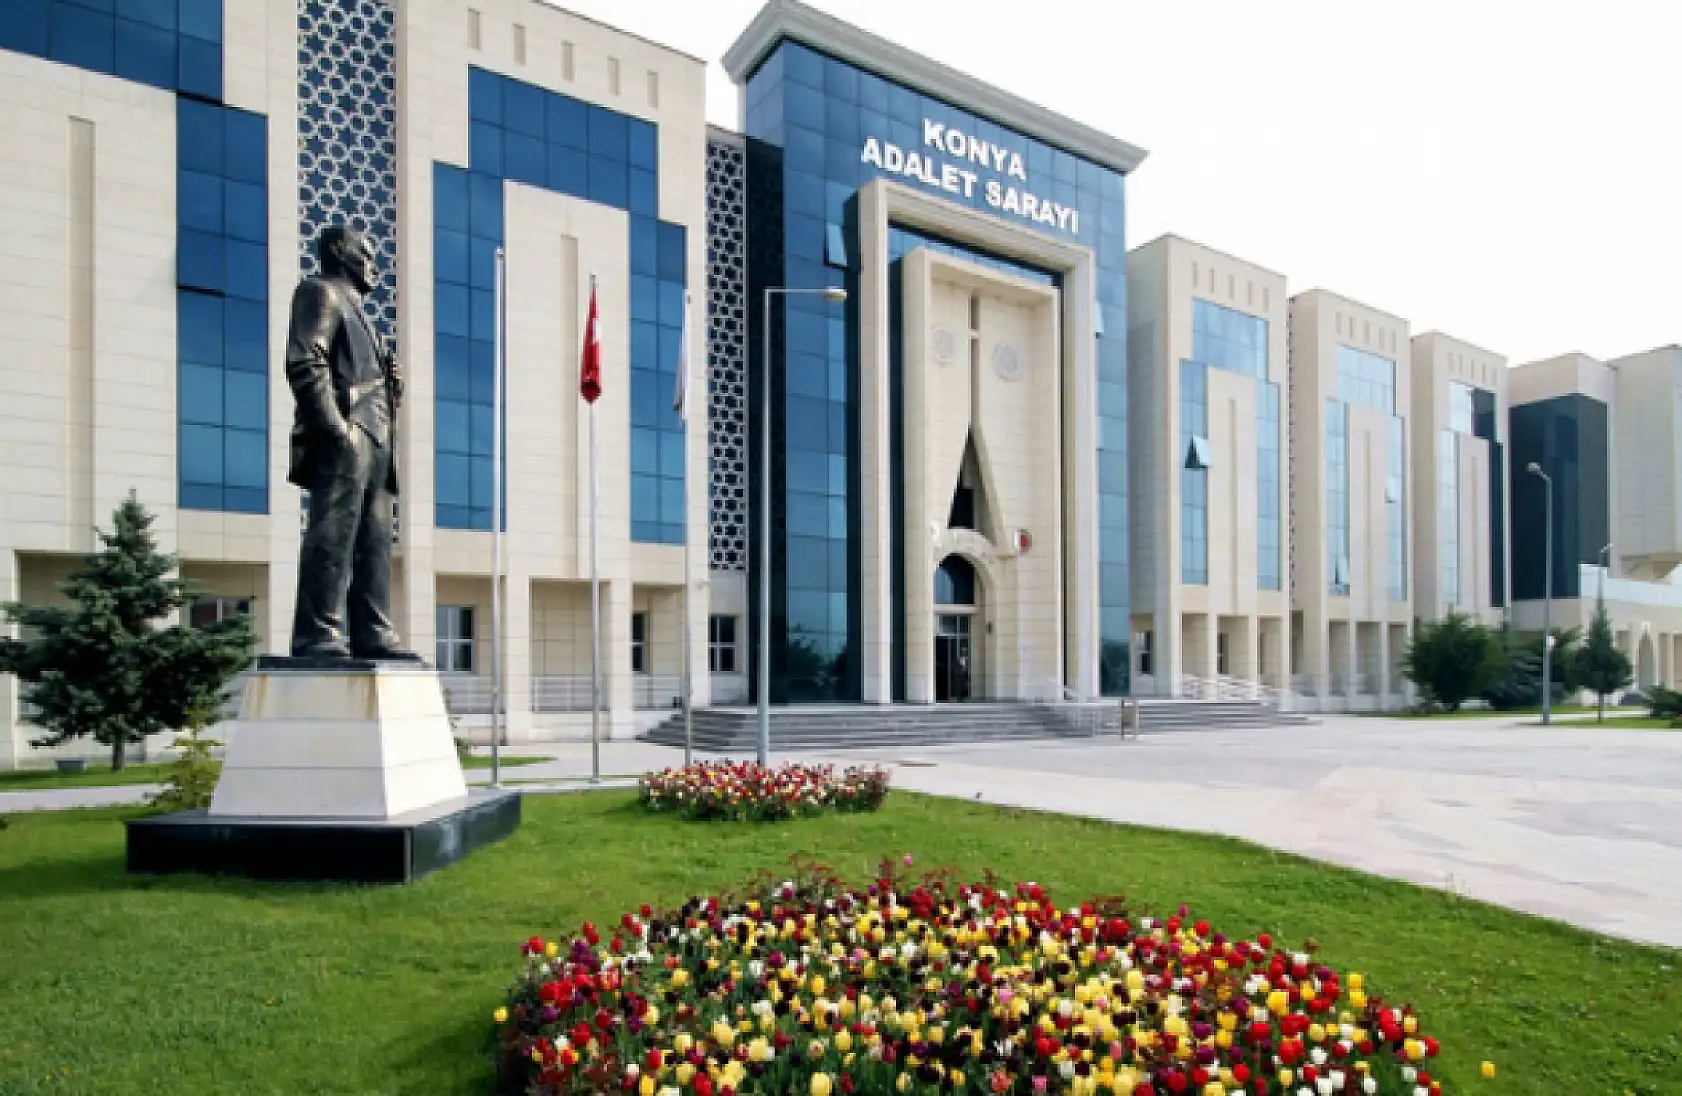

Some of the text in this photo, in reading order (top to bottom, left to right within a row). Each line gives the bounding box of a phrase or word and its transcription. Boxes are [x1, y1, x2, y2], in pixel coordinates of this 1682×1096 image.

[861, 136, 1078, 235] ADALET SARAYI
[924, 118, 1026, 182] KONYA
